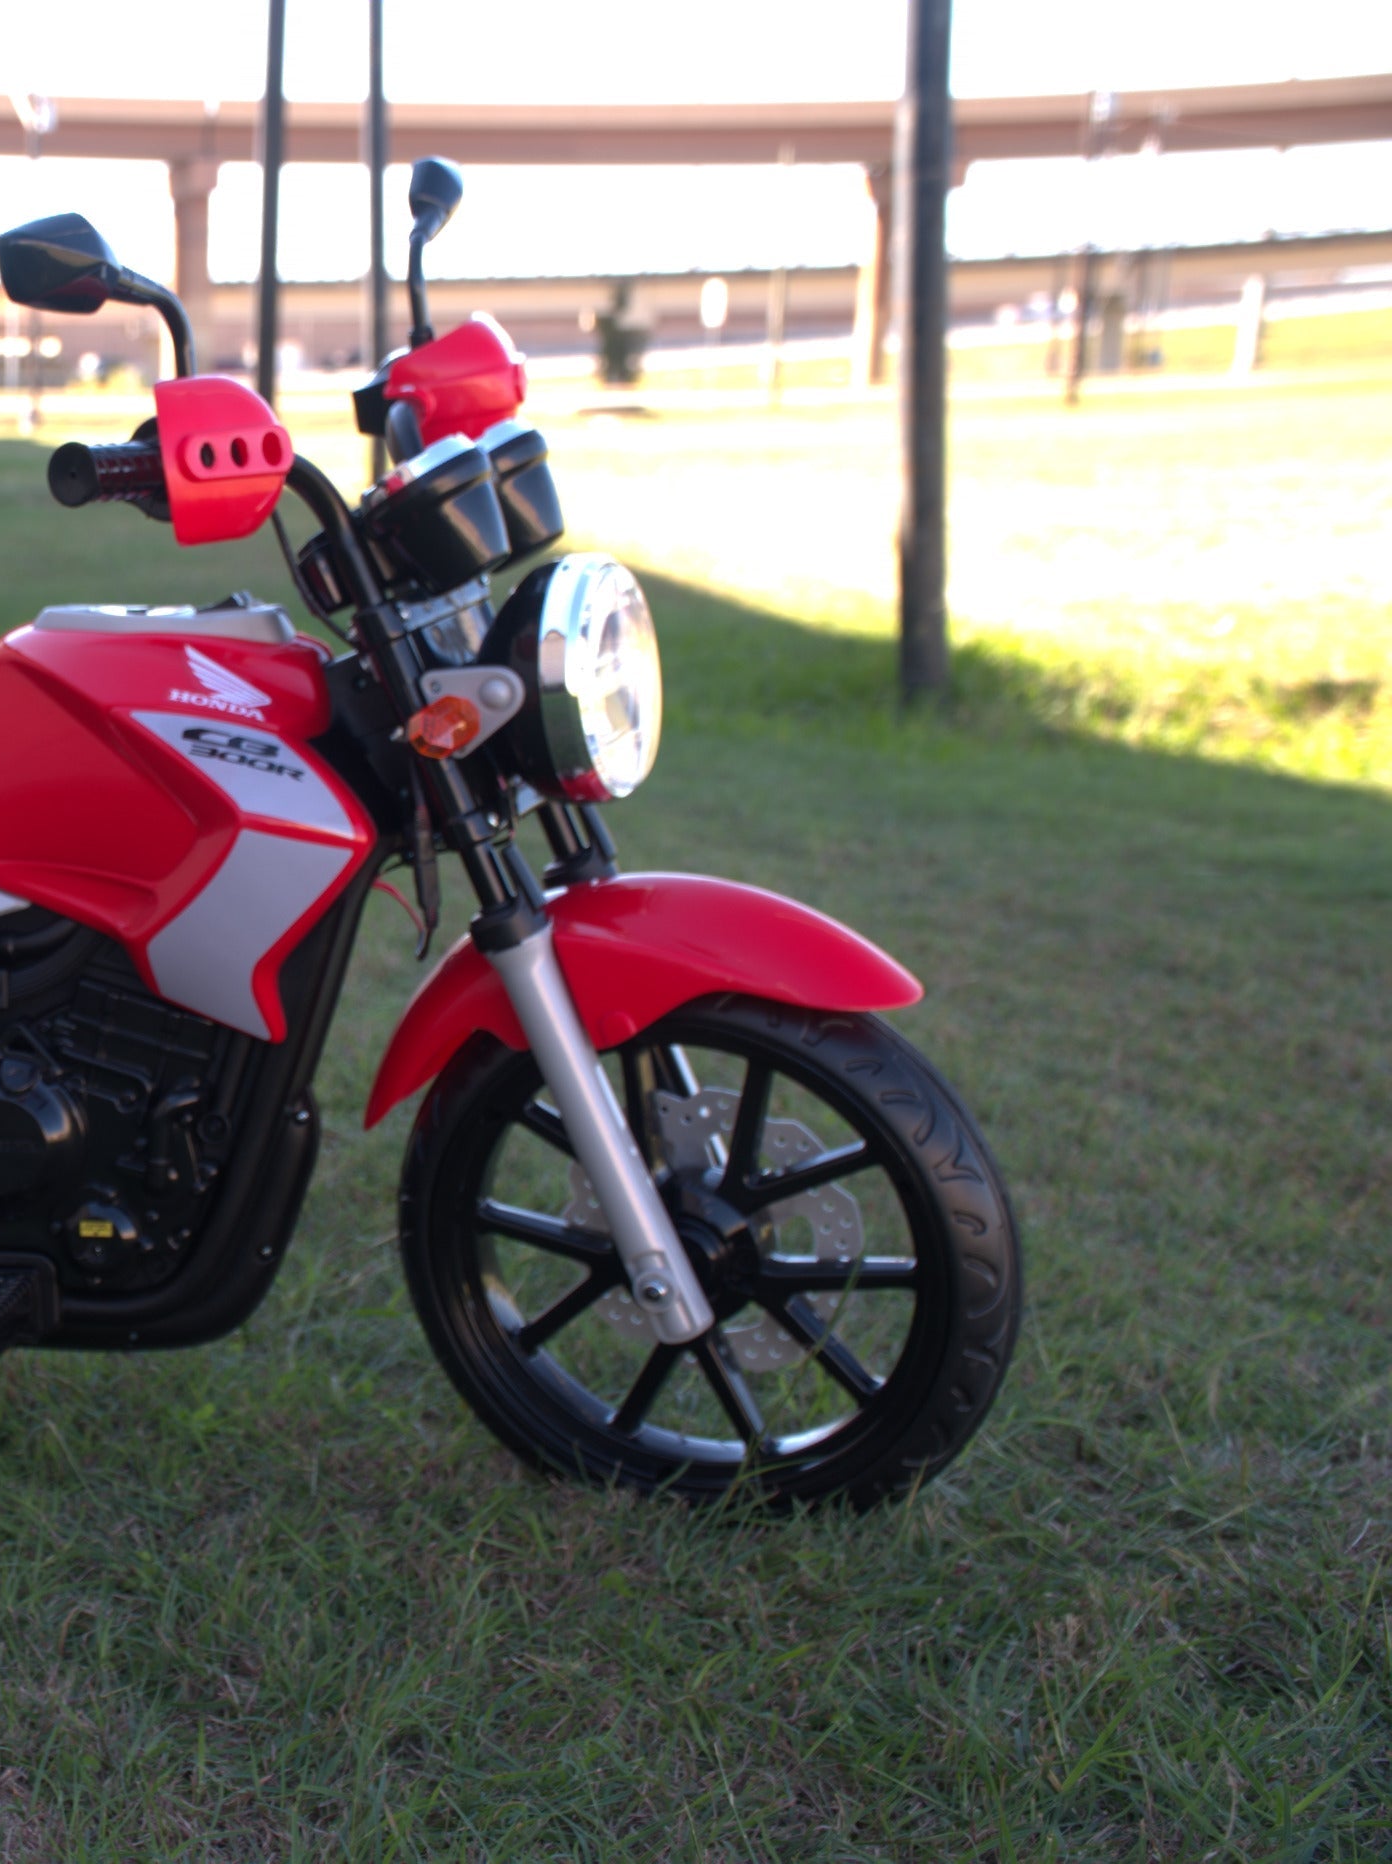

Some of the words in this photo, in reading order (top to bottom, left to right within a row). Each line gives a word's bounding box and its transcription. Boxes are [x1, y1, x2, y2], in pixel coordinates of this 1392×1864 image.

[169, 690, 263, 721] HONDA
[182, 728, 279, 757] CB
[189, 744, 304, 781] 300R
